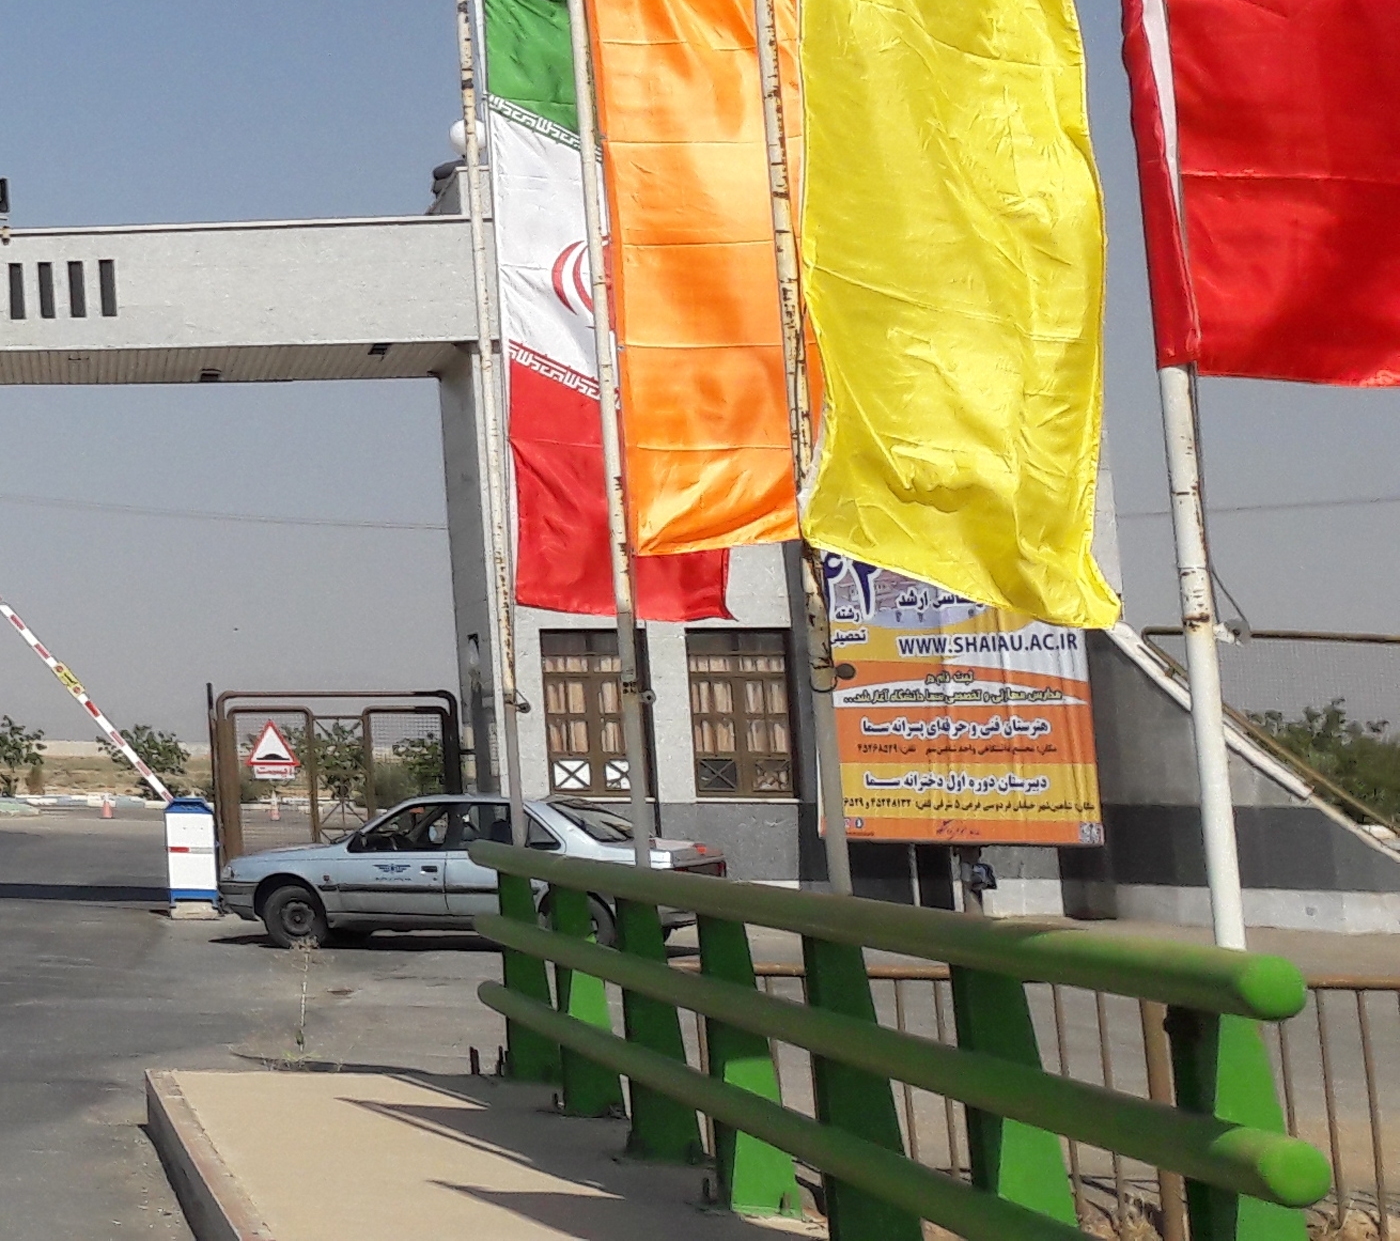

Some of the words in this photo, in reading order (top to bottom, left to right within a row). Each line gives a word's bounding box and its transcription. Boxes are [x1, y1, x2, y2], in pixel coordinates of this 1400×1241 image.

[898, 590, 929, 610] ارشد
[835, 608, 860, 623] رشته
[899, 633, 1078, 656] WWW.SHAIAU.AC.IR
[862, 719, 890, 733] سما
[980, 716, 1001, 736] فنی
[1003, 717, 1049, 737] هنرستان
[864, 773, 901, 787] سما
[903, 772, 944, 792] دخترانه
[946, 773, 966, 792] اول
[968, 775, 996, 793] دوره
[998, 774, 1048, 793] دبیرستان
